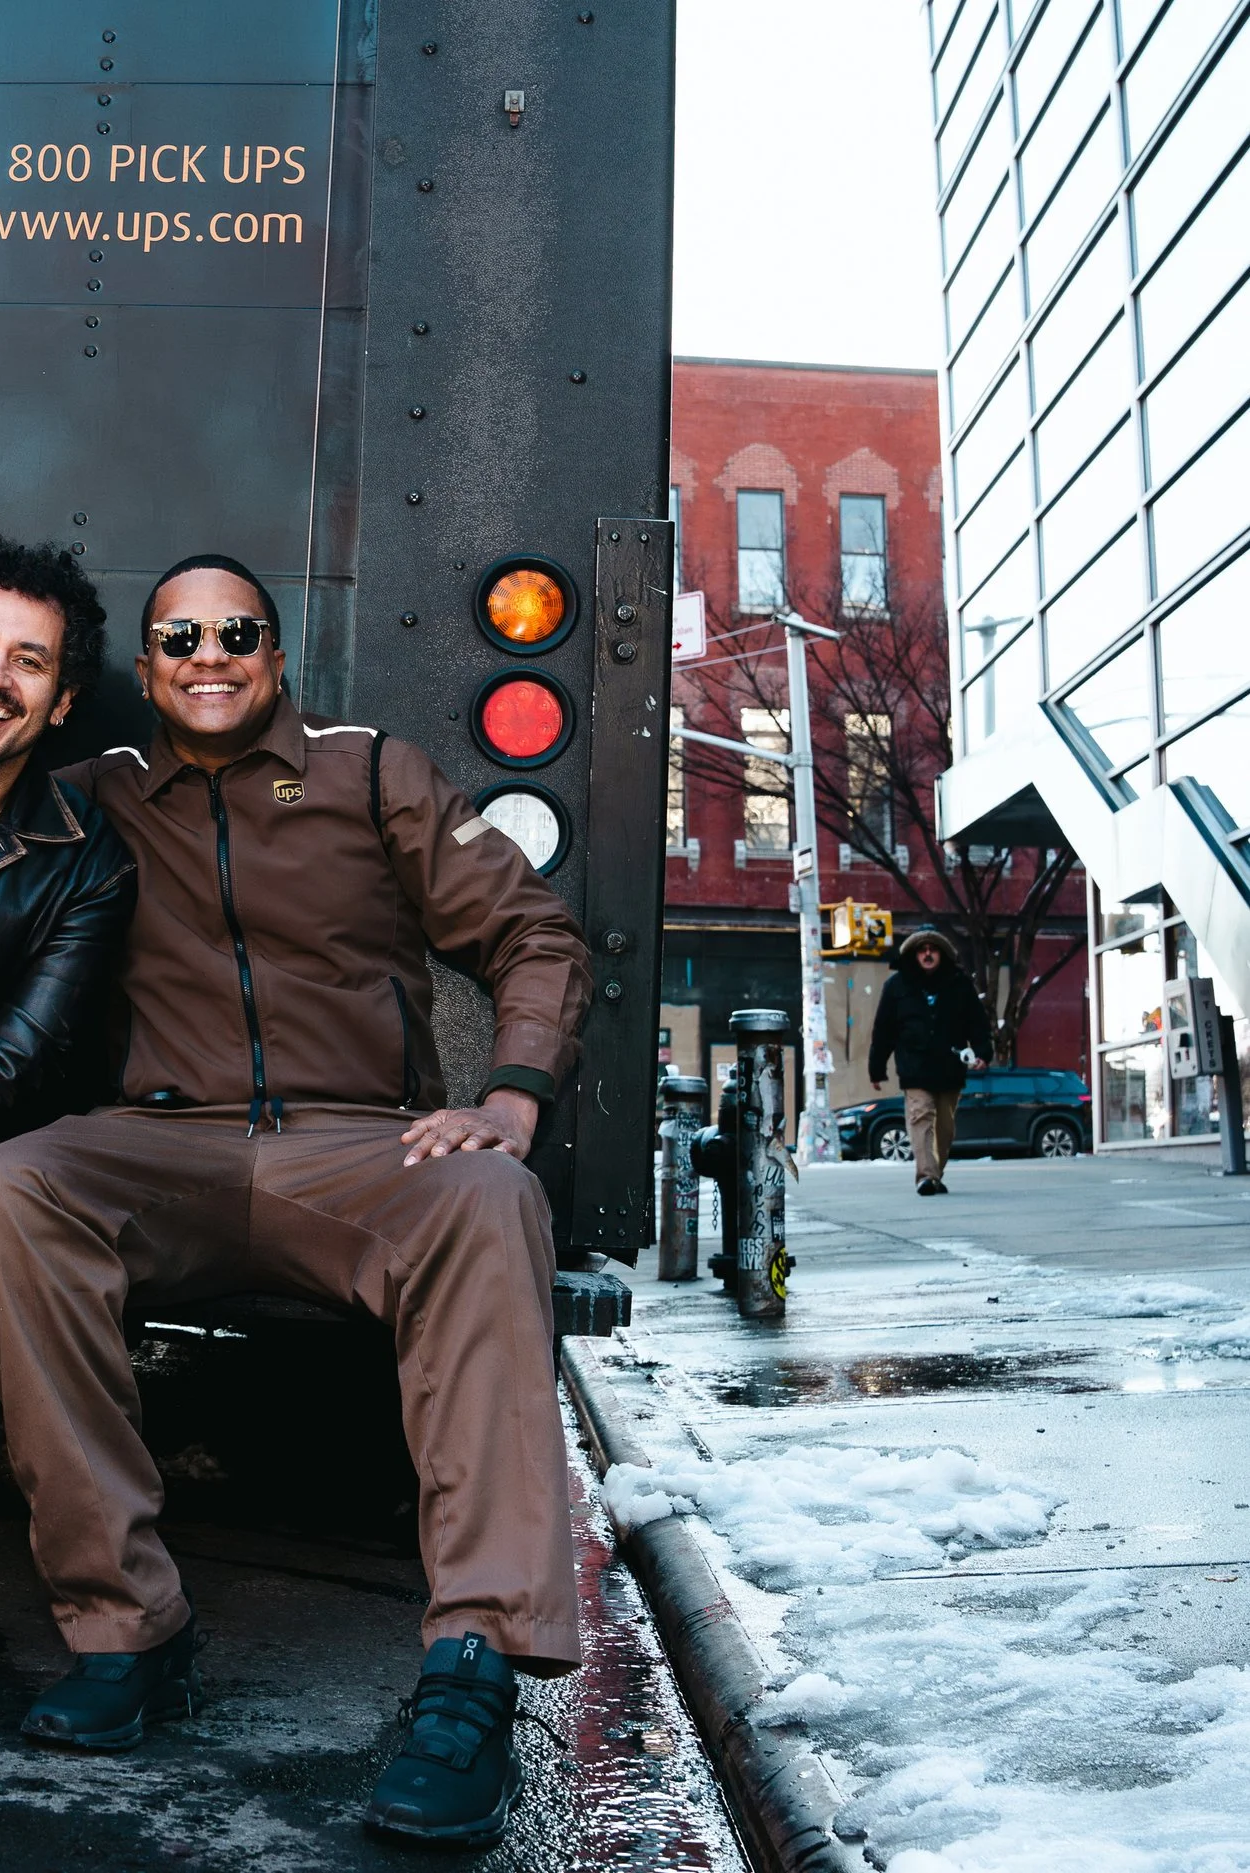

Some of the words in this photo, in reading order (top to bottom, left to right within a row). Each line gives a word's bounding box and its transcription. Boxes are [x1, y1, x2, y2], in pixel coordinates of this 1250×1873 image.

[109, 144, 207, 184] PICK
[223, 145, 306, 185] UPS
[276, 787, 302, 801] ups
[1203, 1000, 1216, 1067] TCKETS
